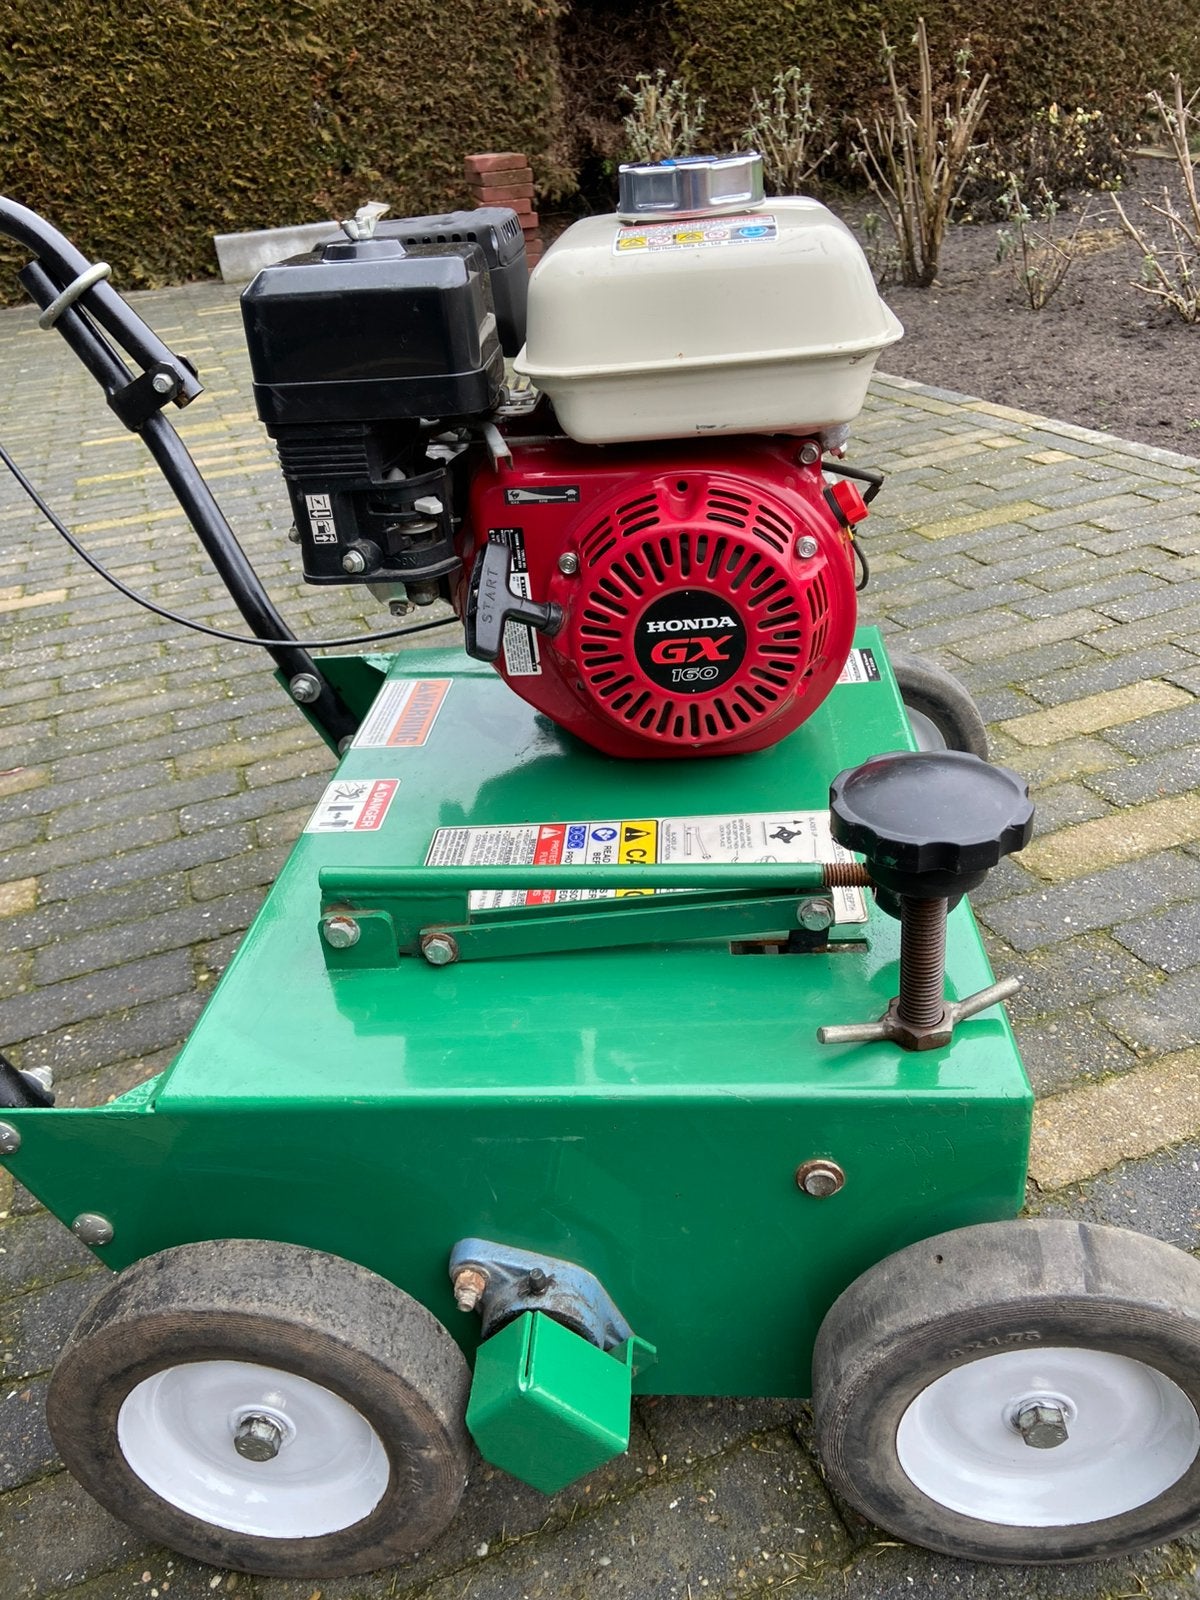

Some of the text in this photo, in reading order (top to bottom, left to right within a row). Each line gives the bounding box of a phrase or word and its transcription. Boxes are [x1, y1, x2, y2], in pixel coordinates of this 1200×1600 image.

[482, 567, 498, 624] START
[646, 616, 737, 633] HONDA
[650, 634, 734, 665] GX
[672, 666, 719, 682] 160
[393, 690, 438, 744] WARNING
[360, 791, 387, 828] DANGER
[592, 852, 601, 864] BEF
[602, 846, 612, 863] READ
